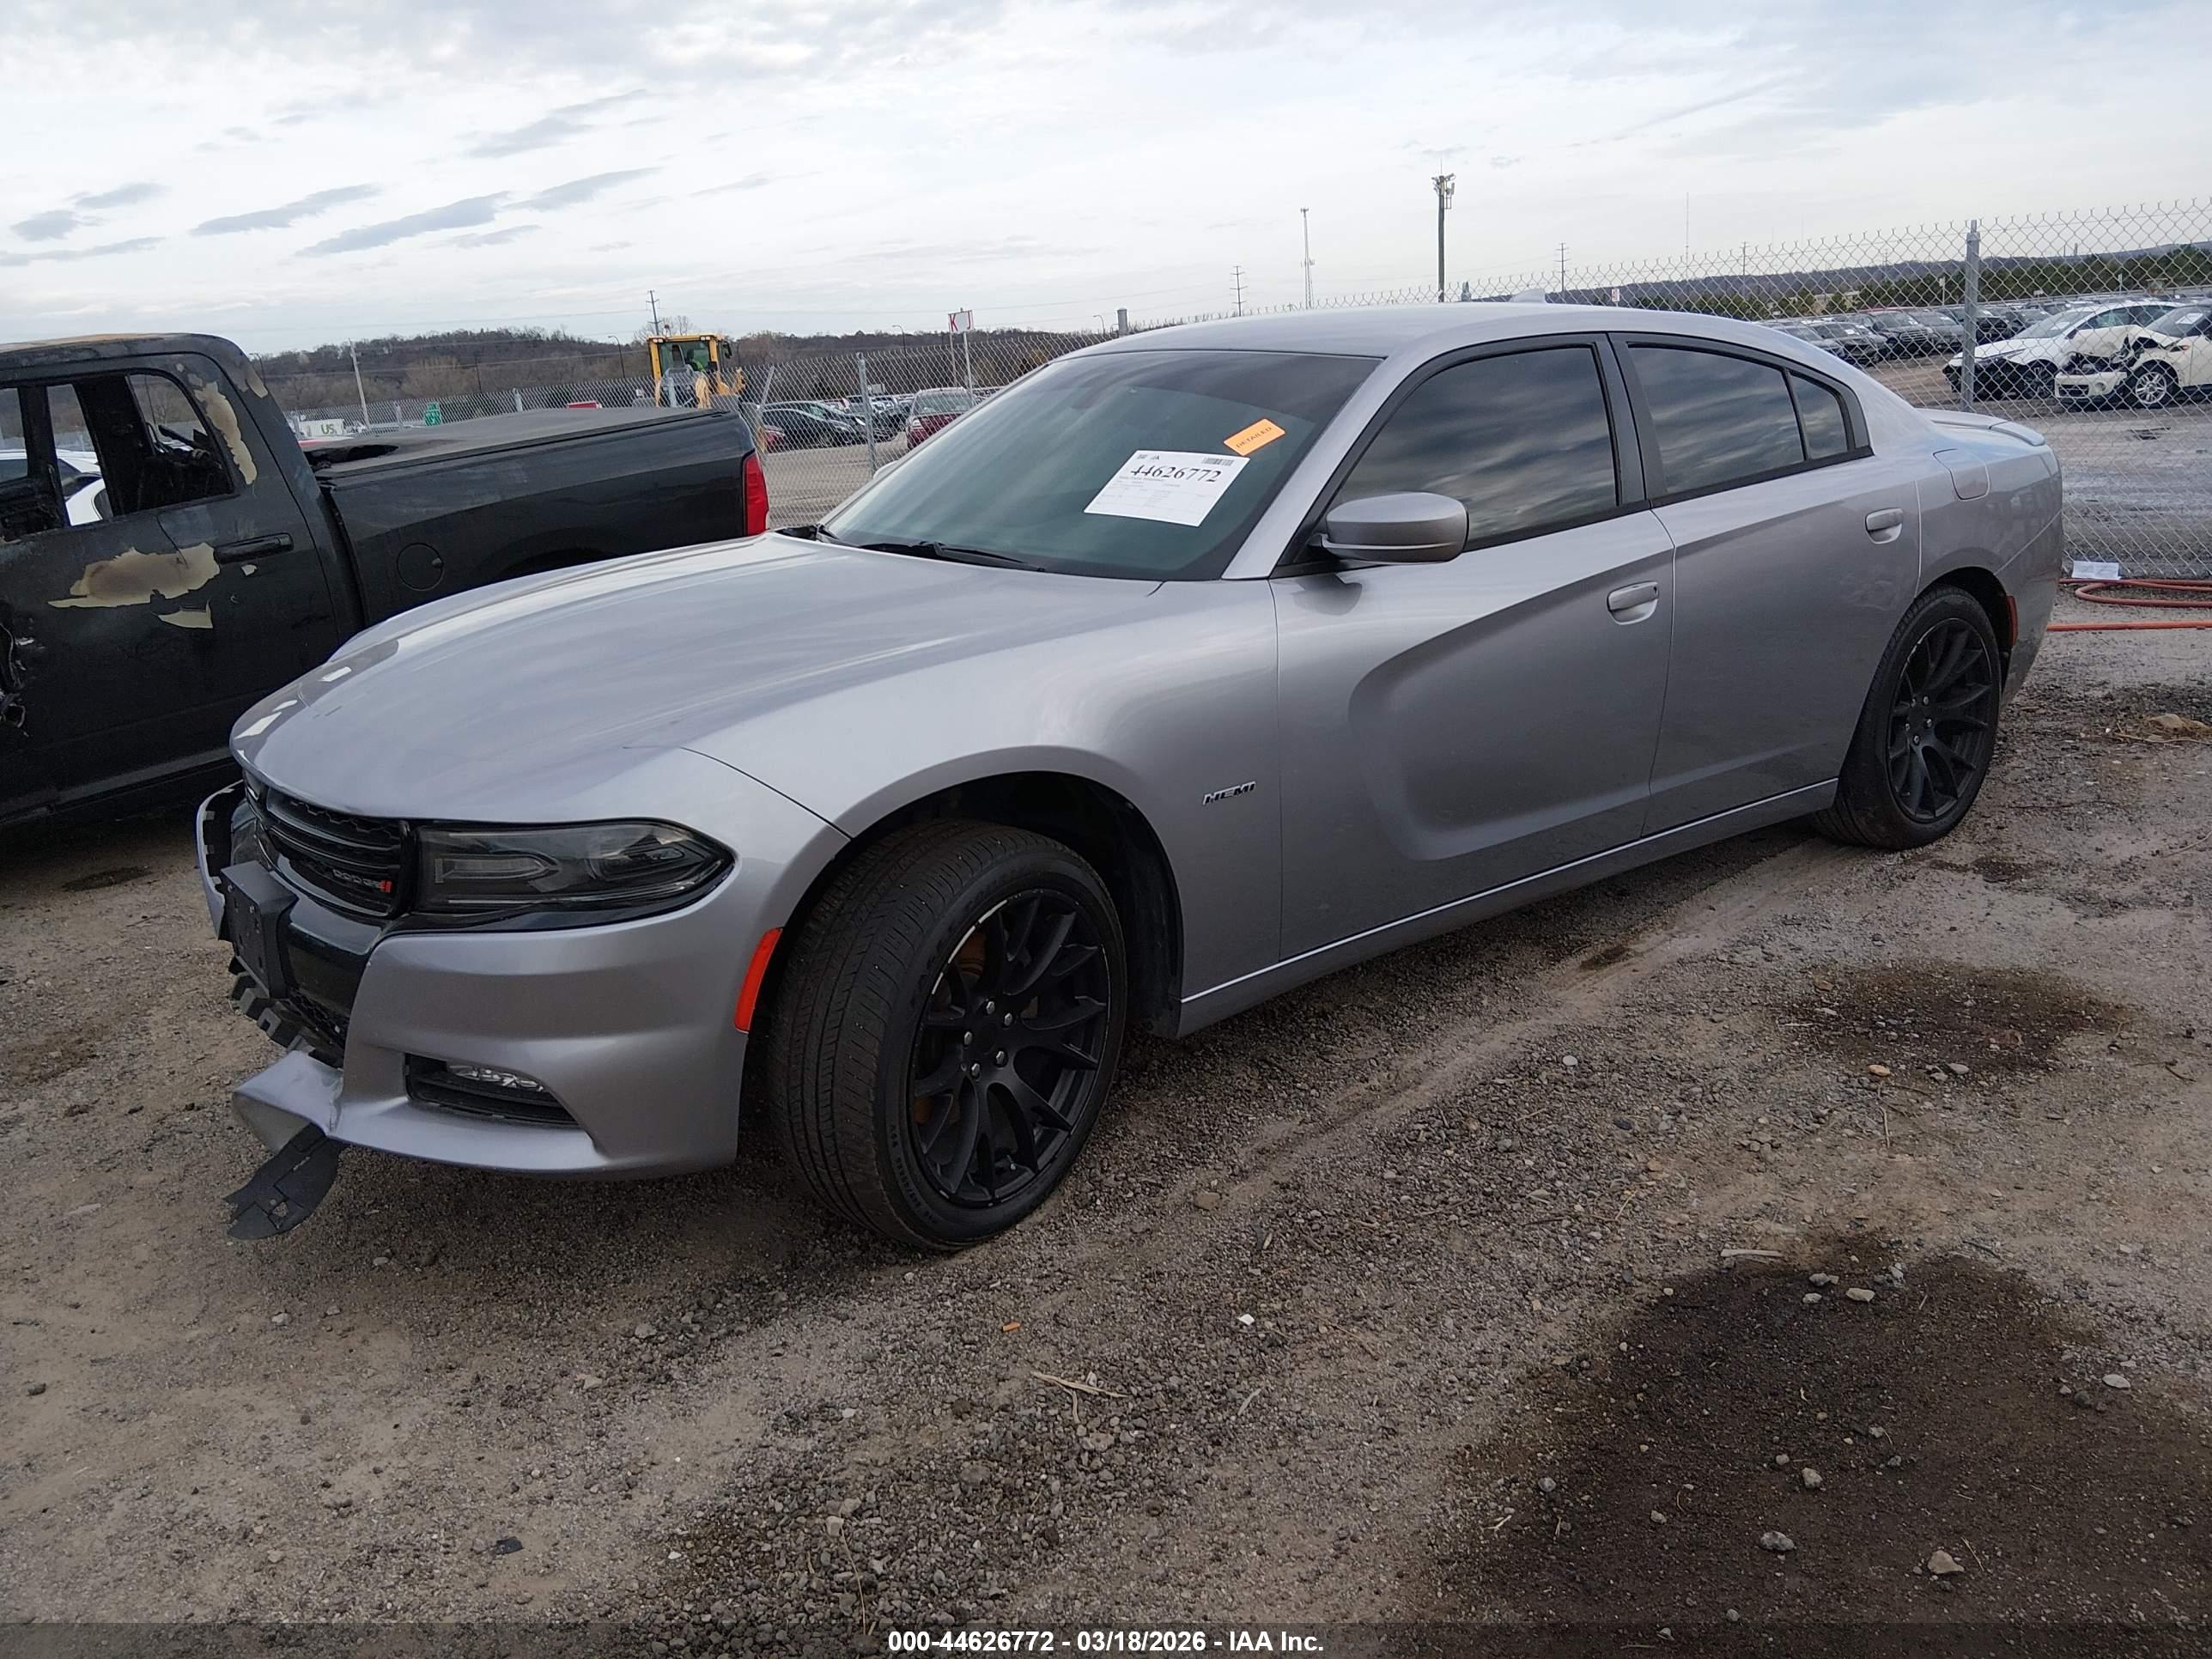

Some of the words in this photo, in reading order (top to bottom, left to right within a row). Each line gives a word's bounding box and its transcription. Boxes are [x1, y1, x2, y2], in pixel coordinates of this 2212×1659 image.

[950, 313, 958, 332] K
[966, 311, 971, 331] J
[1235, 426, 1273, 448] DETAILED
[1130, 464, 1223, 483] 44626772
[1202, 781, 1256, 805] HEMI
